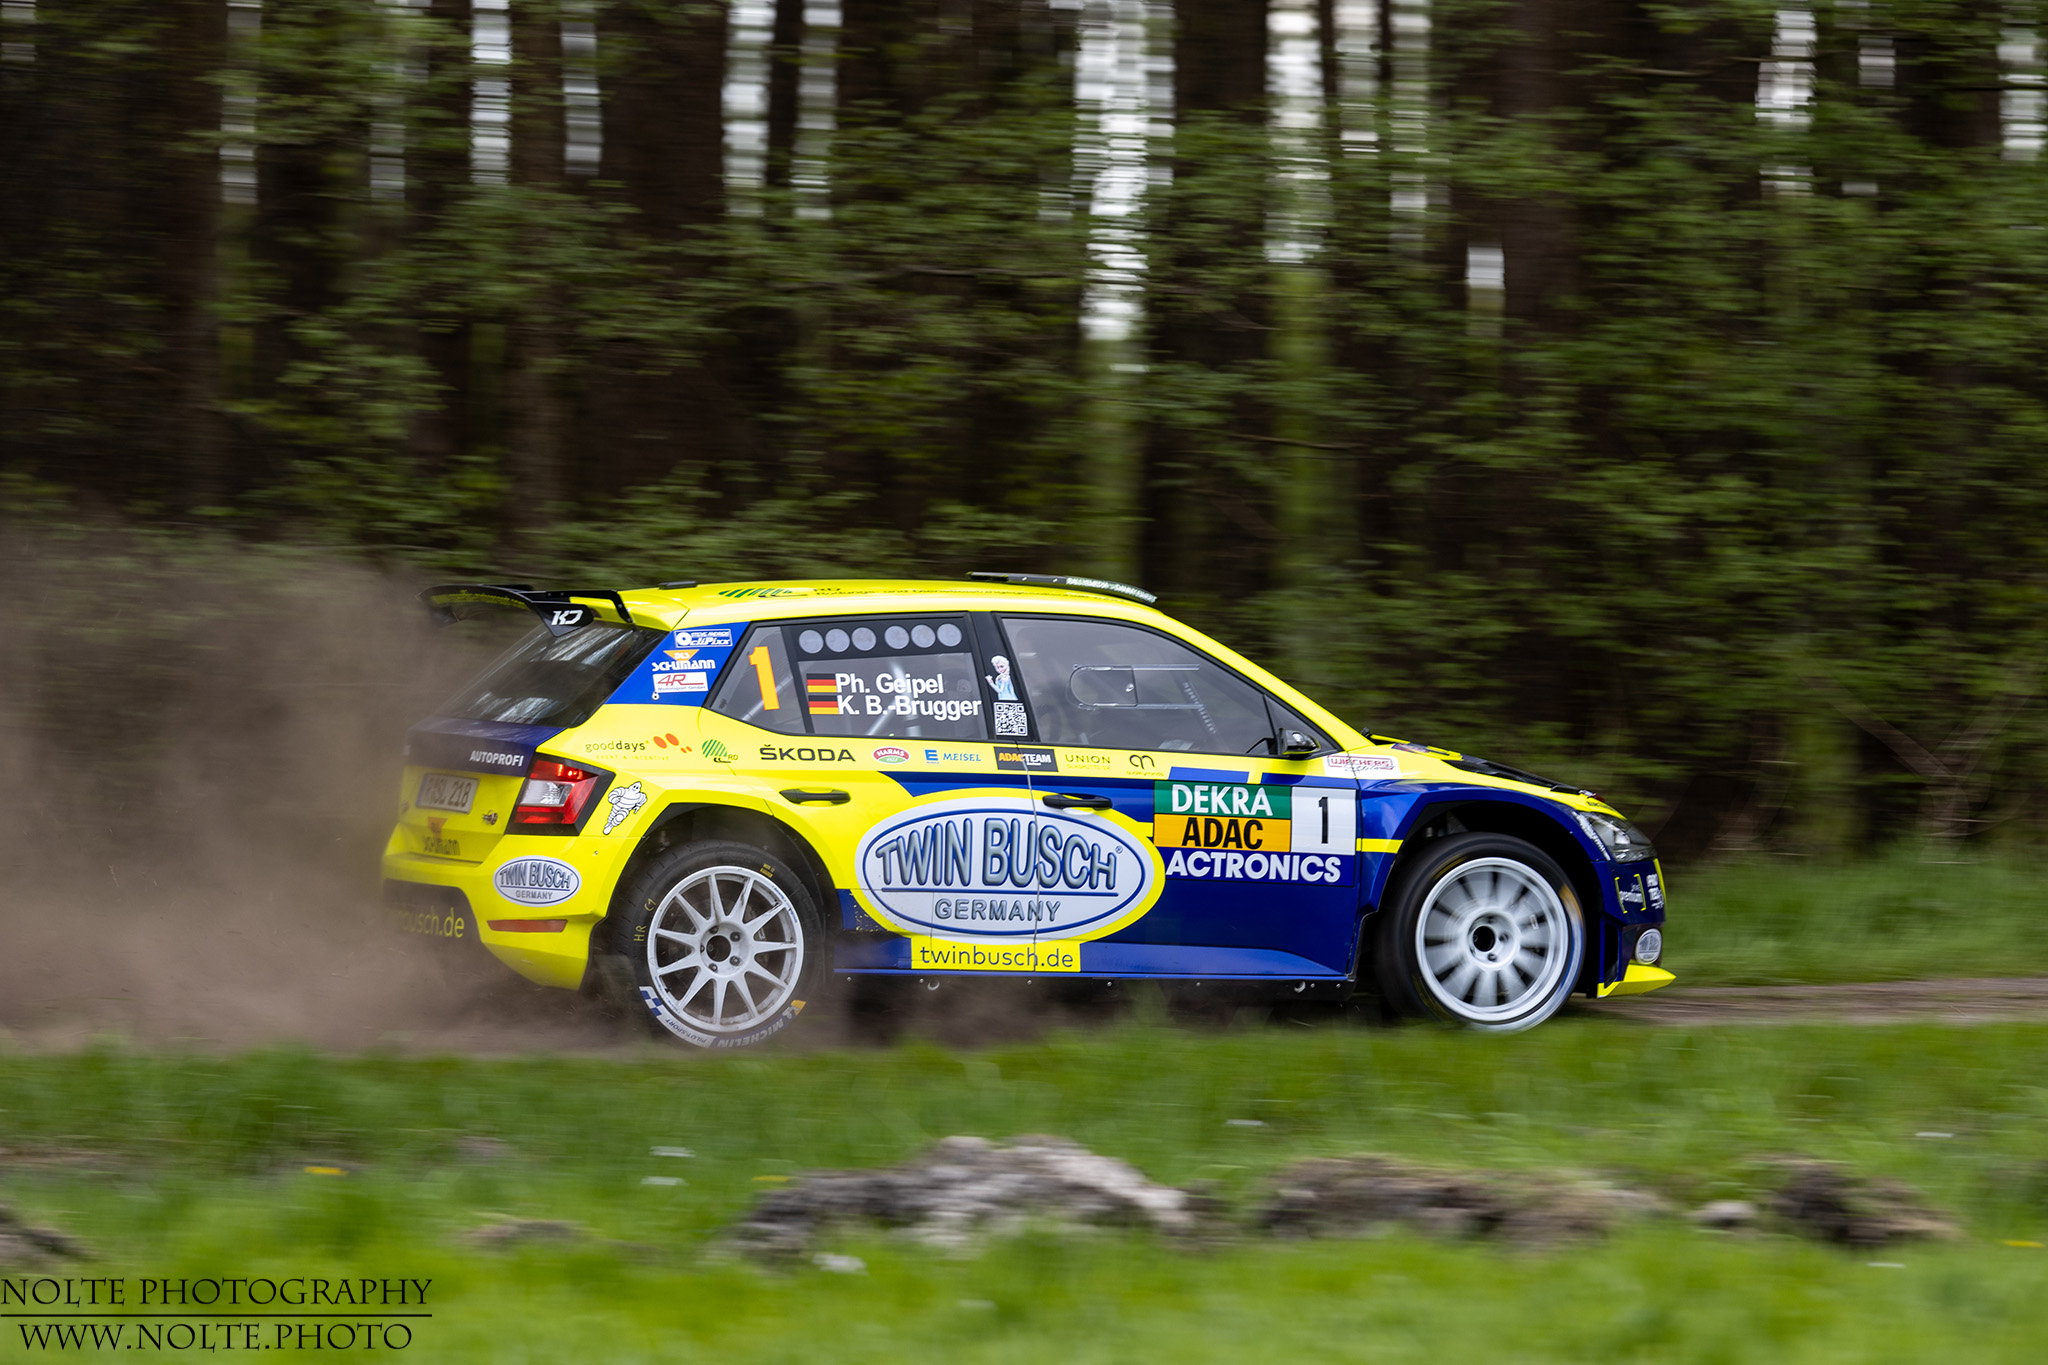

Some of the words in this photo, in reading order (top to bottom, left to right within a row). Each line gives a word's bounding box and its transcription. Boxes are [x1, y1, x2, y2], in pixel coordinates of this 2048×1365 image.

[749, 646, 780, 711] 1
[835, 673, 870, 694] Ph.
[876, 673, 944, 698] Geipel
[837, 695, 860, 715] K.
[866, 695, 982, 721] B.-Brugger
[469, 750, 524, 767] AUTOPROFI
[585, 740, 646, 753] gooddays
[759, 744, 856, 762] ŠKODA
[943, 753, 982, 762] MEISEL
[1065, 754, 1111, 764] UNION
[1171, 784, 1274, 817] DEKRA
[1317, 796, 1329, 844] 1
[1181, 816, 1264, 850] ADAC
[876, 817, 973, 887] TWIN
[982, 817, 1117, 890] BUSCH
[500, 861, 527, 887] TWIN
[529, 861, 572, 889] BUSCH
[1165, 850, 1342, 883] ACTRONICS
[515, 889, 553, 900] GERMANY
[934, 898, 1062, 922] GERMANY
[920, 946, 1074, 968] twinbusch.de
[664, 1018, 688, 1036] SPORT
[717, 1018, 785, 1049] MICHELIN
